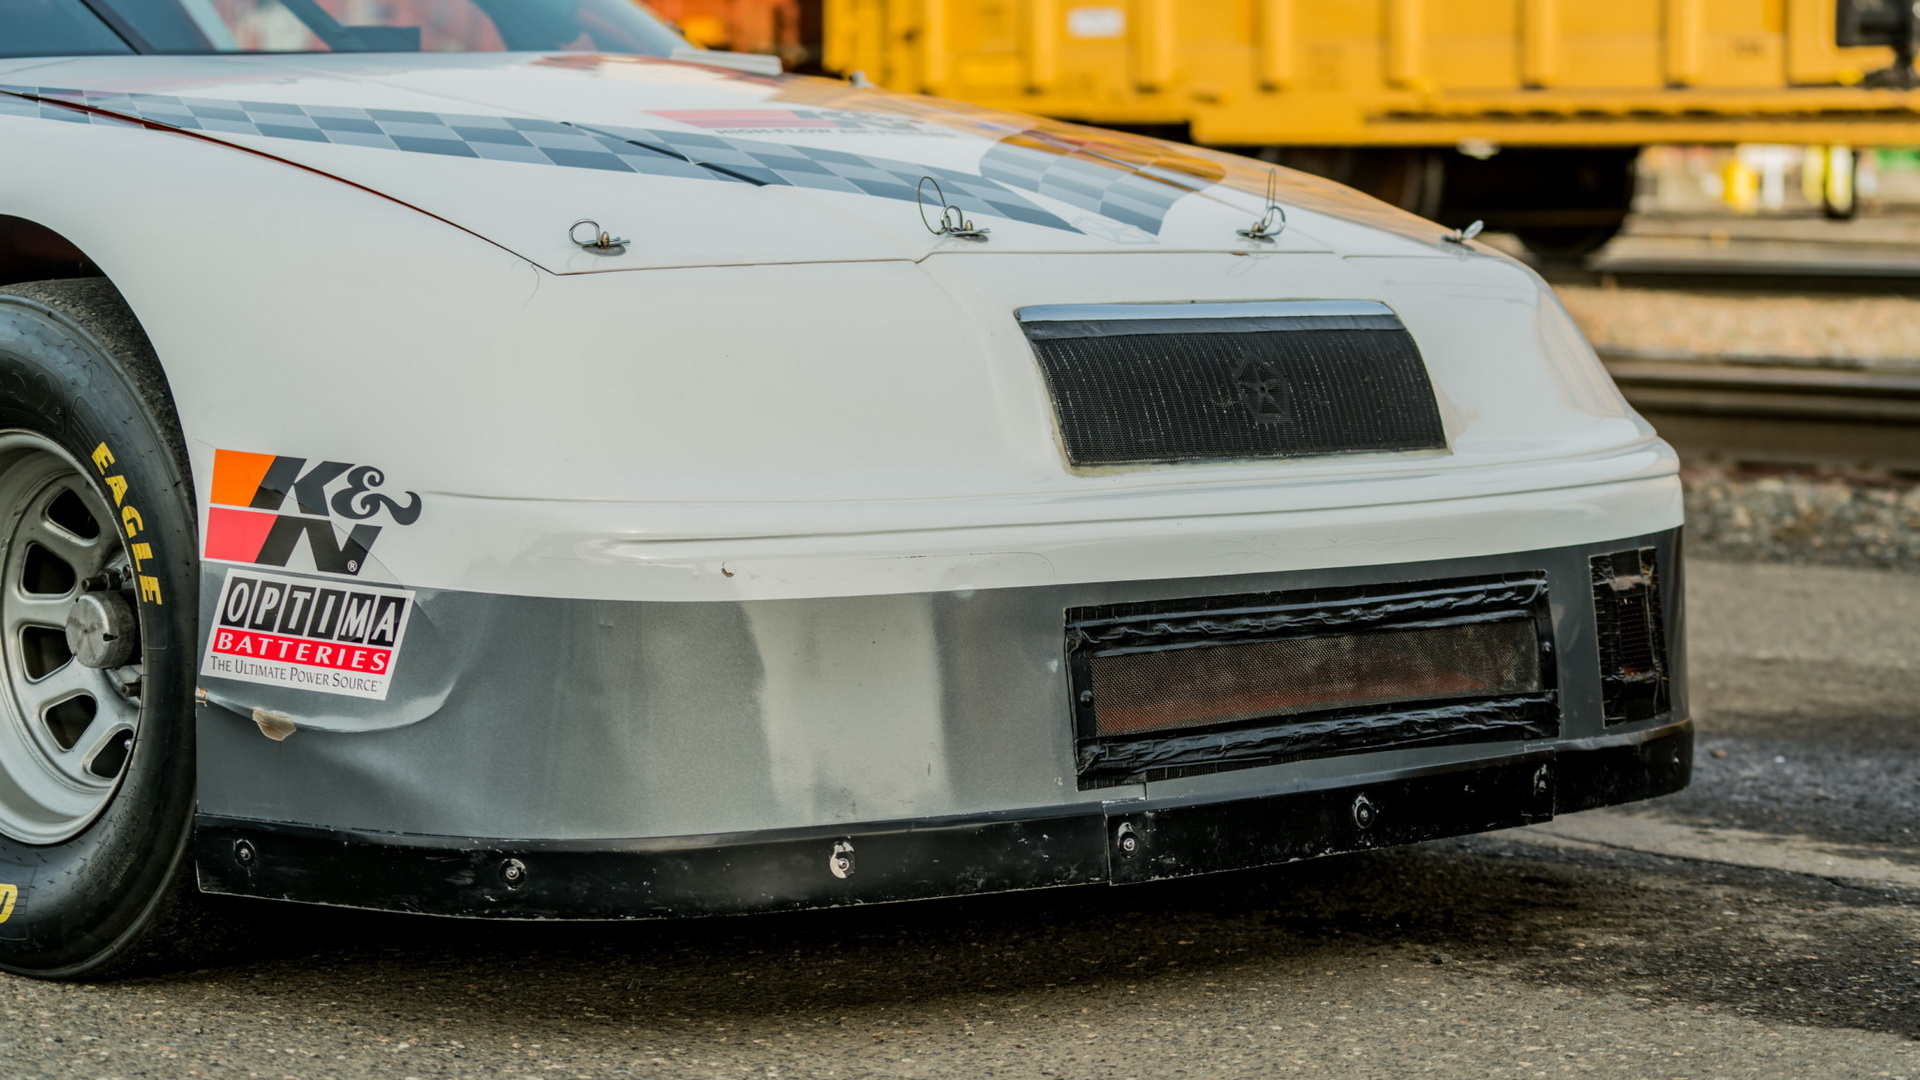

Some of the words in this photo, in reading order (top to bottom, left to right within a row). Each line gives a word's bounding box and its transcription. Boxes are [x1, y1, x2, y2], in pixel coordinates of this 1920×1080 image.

[91, 441, 163, 605] EAGLE
[227, 582, 396, 643] OPTIMA
[217, 632, 387, 671] BATTERIES
